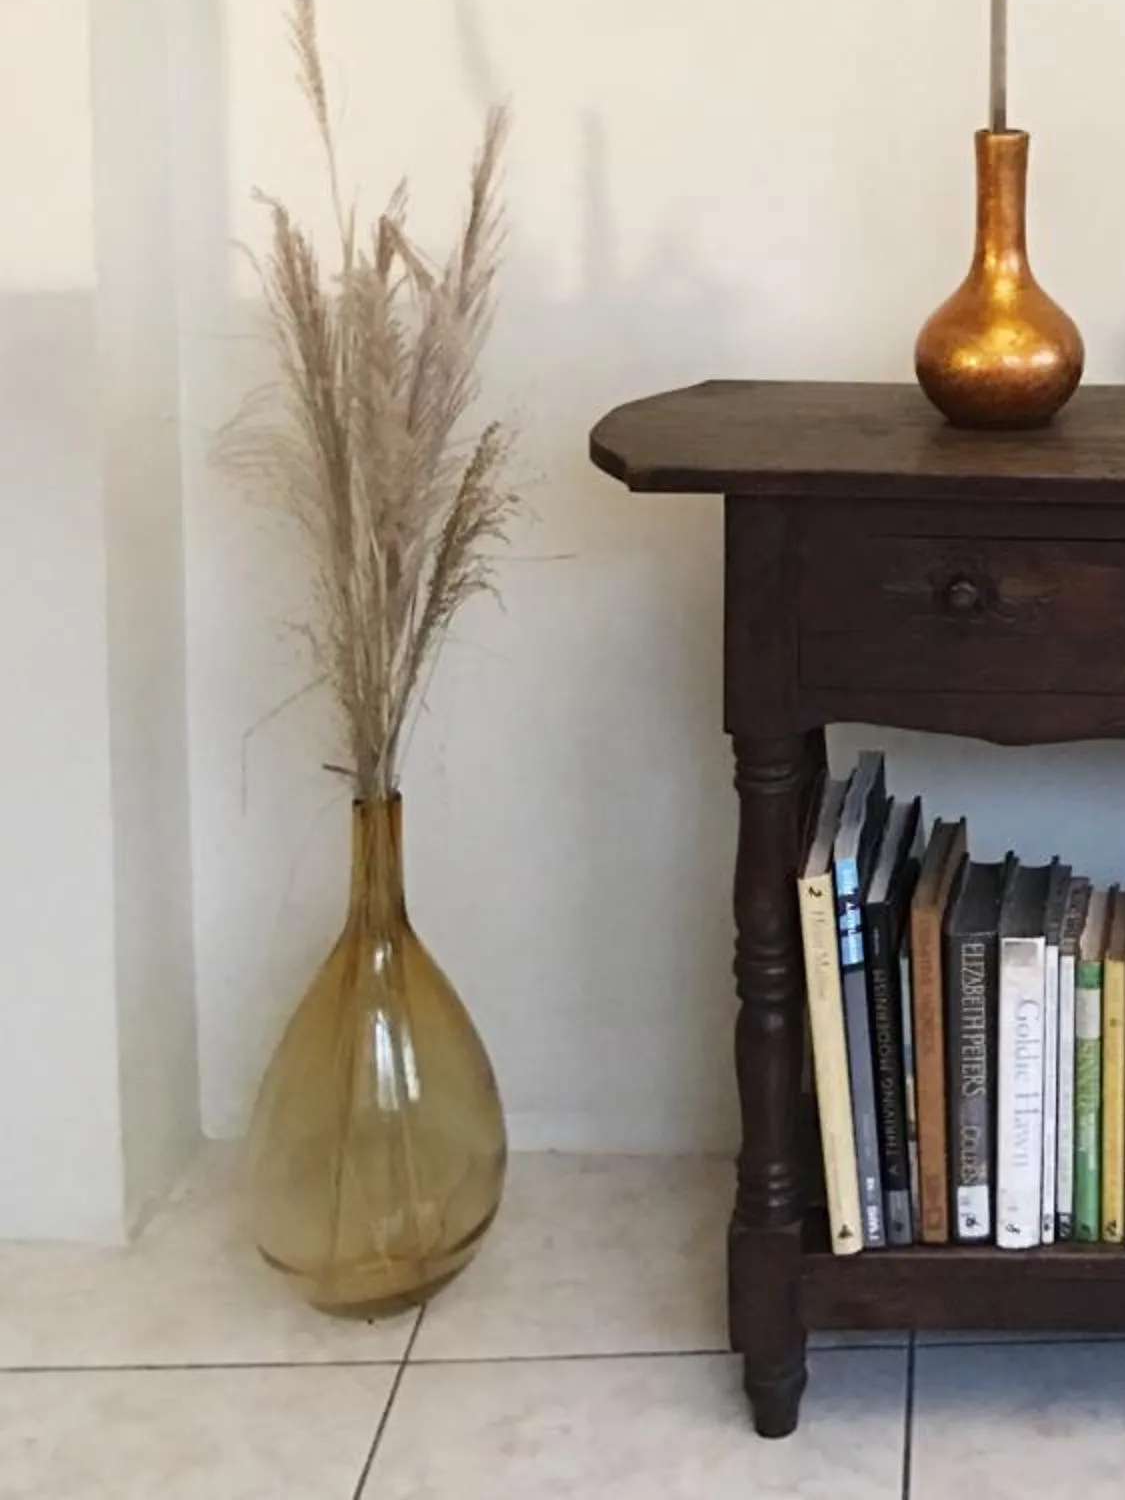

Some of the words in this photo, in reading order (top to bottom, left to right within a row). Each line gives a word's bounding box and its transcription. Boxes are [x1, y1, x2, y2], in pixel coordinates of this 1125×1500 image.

[873, 968, 895, 1072] MODERNISM
[961, 941, 987, 1030] ELIZABETH
[961, 1032, 987, 1097] PETERS
[1013, 998, 1038, 1080] Goldie
[880, 1078, 899, 1158] THRIVING
[1012, 1093, 1038, 1167] Hawn
